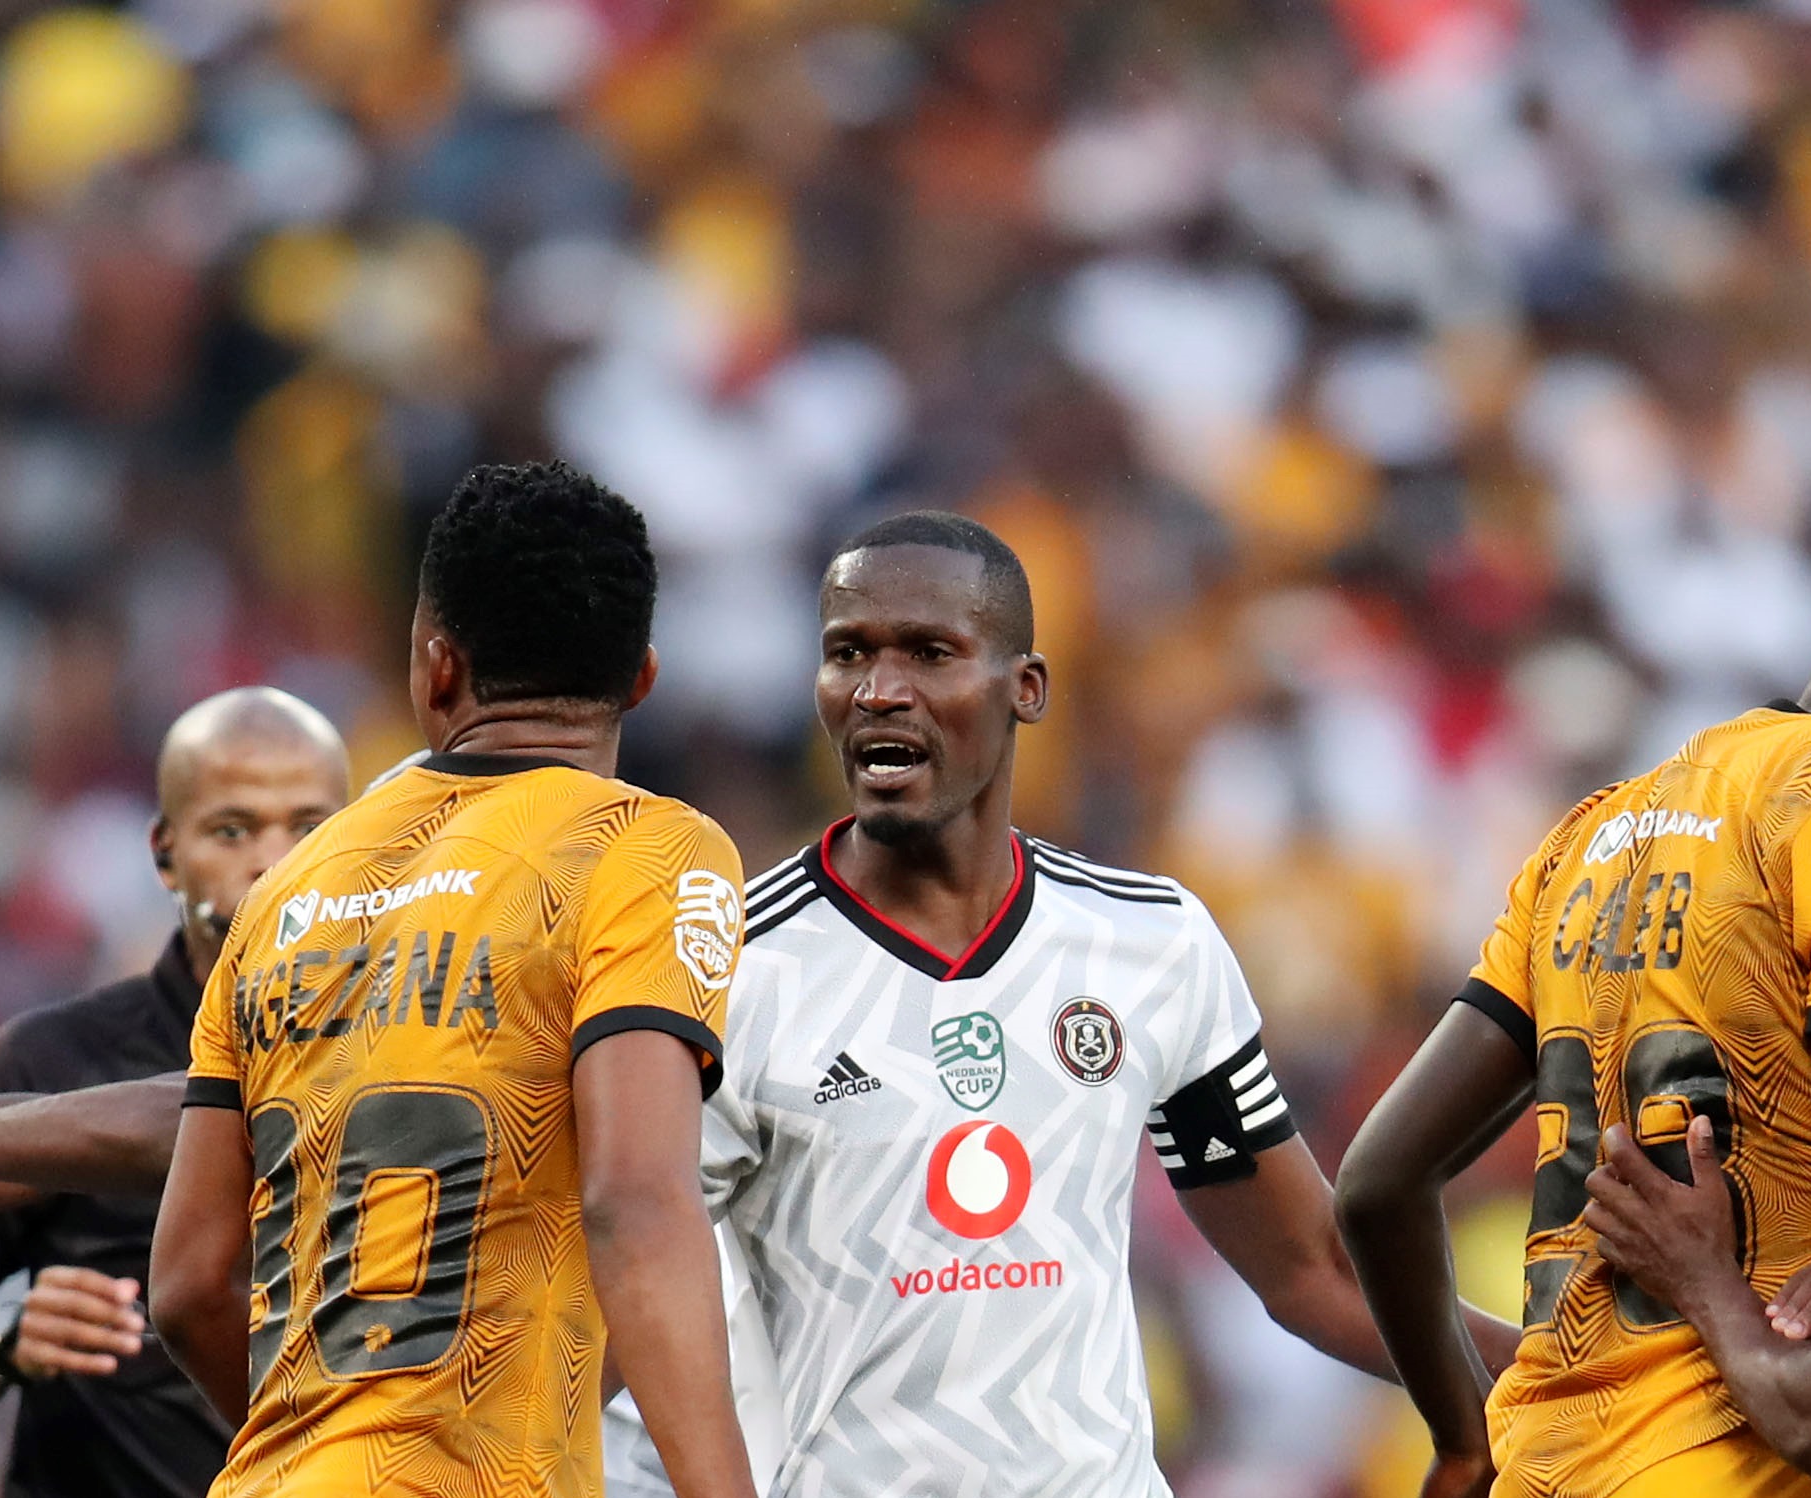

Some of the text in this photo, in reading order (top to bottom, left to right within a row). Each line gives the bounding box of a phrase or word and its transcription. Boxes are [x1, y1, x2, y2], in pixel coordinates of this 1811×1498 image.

[1625, 809, 1723, 849] DBANK
[317, 869, 482, 923] NEDBANK
[1552, 871, 1692, 974] CALEB
[687, 939, 729, 974] CUP
[813, 1075, 883, 1105] adidas
[945, 1066, 1000, 1079] NEDBANK
[955, 1077, 994, 1097] CUP
[890, 1257, 1064, 1299] vodacom
